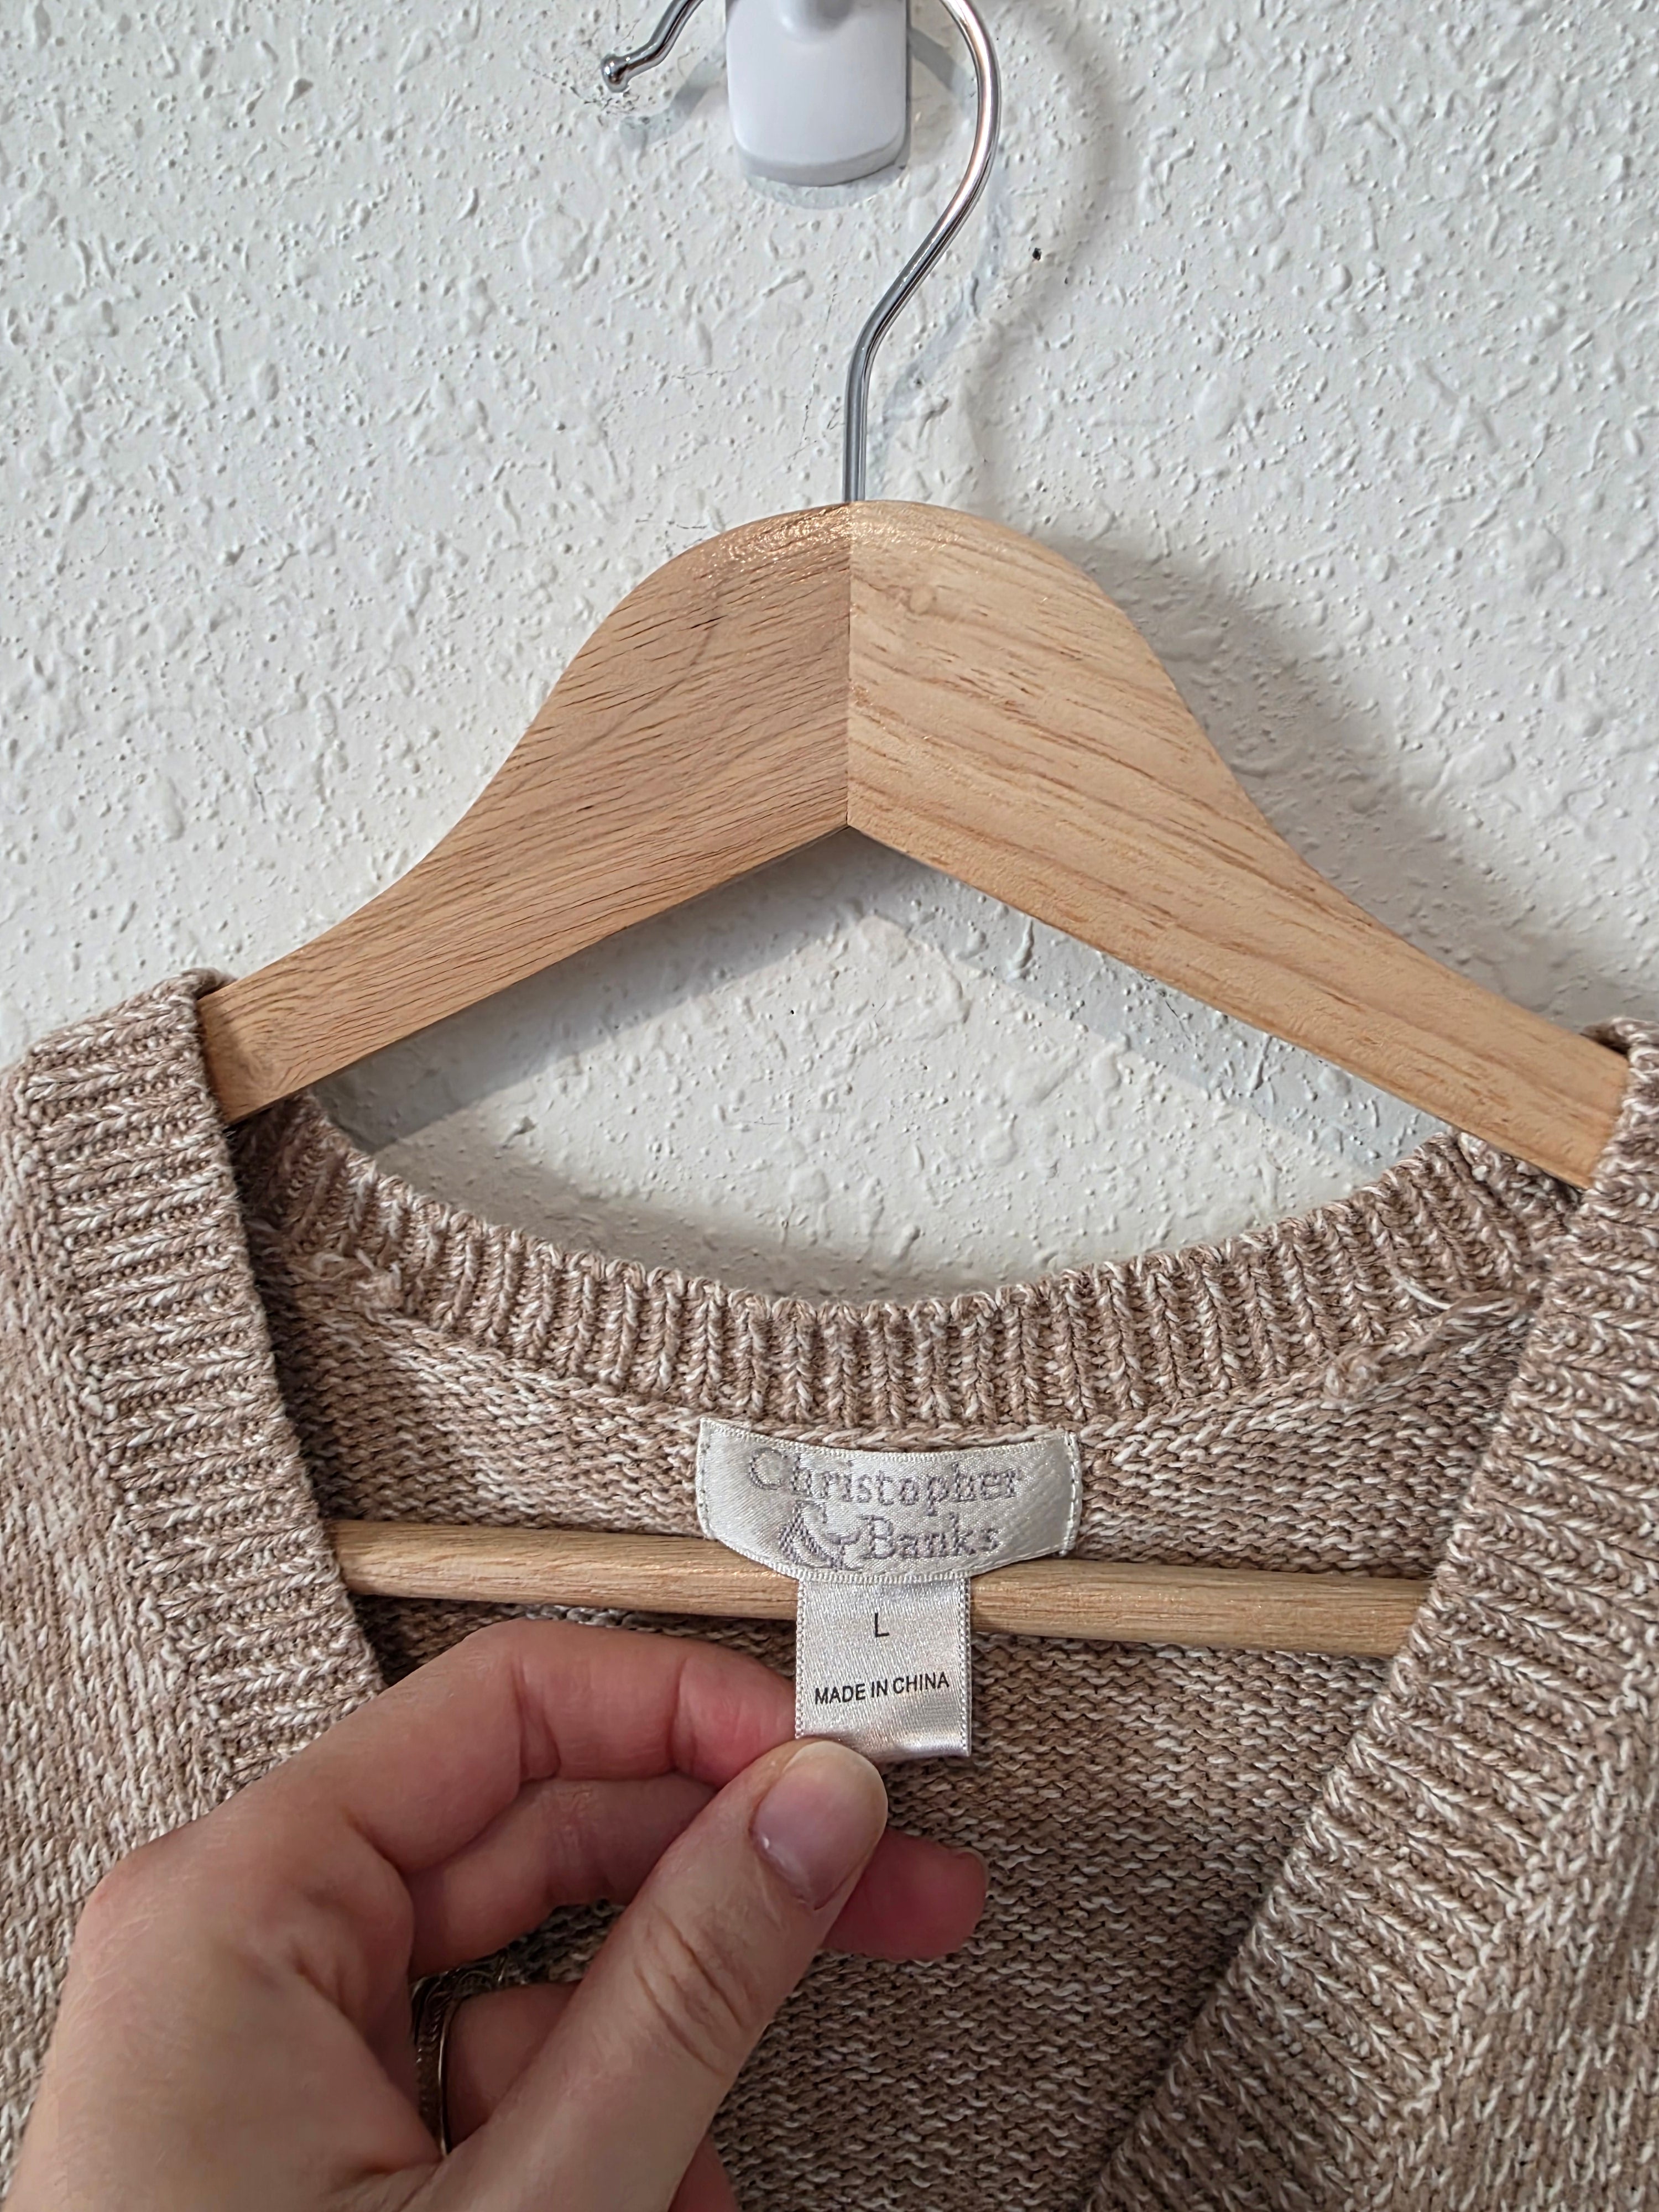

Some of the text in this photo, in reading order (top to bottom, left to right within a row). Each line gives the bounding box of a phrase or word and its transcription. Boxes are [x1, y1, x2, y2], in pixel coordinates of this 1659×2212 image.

[748, 1446, 1022, 1516] Christopher
[779, 1500, 1001, 1571] & Banks
[874, 1612, 890, 1638] L
[815, 1671, 950, 1705] MADE IN CHINA
